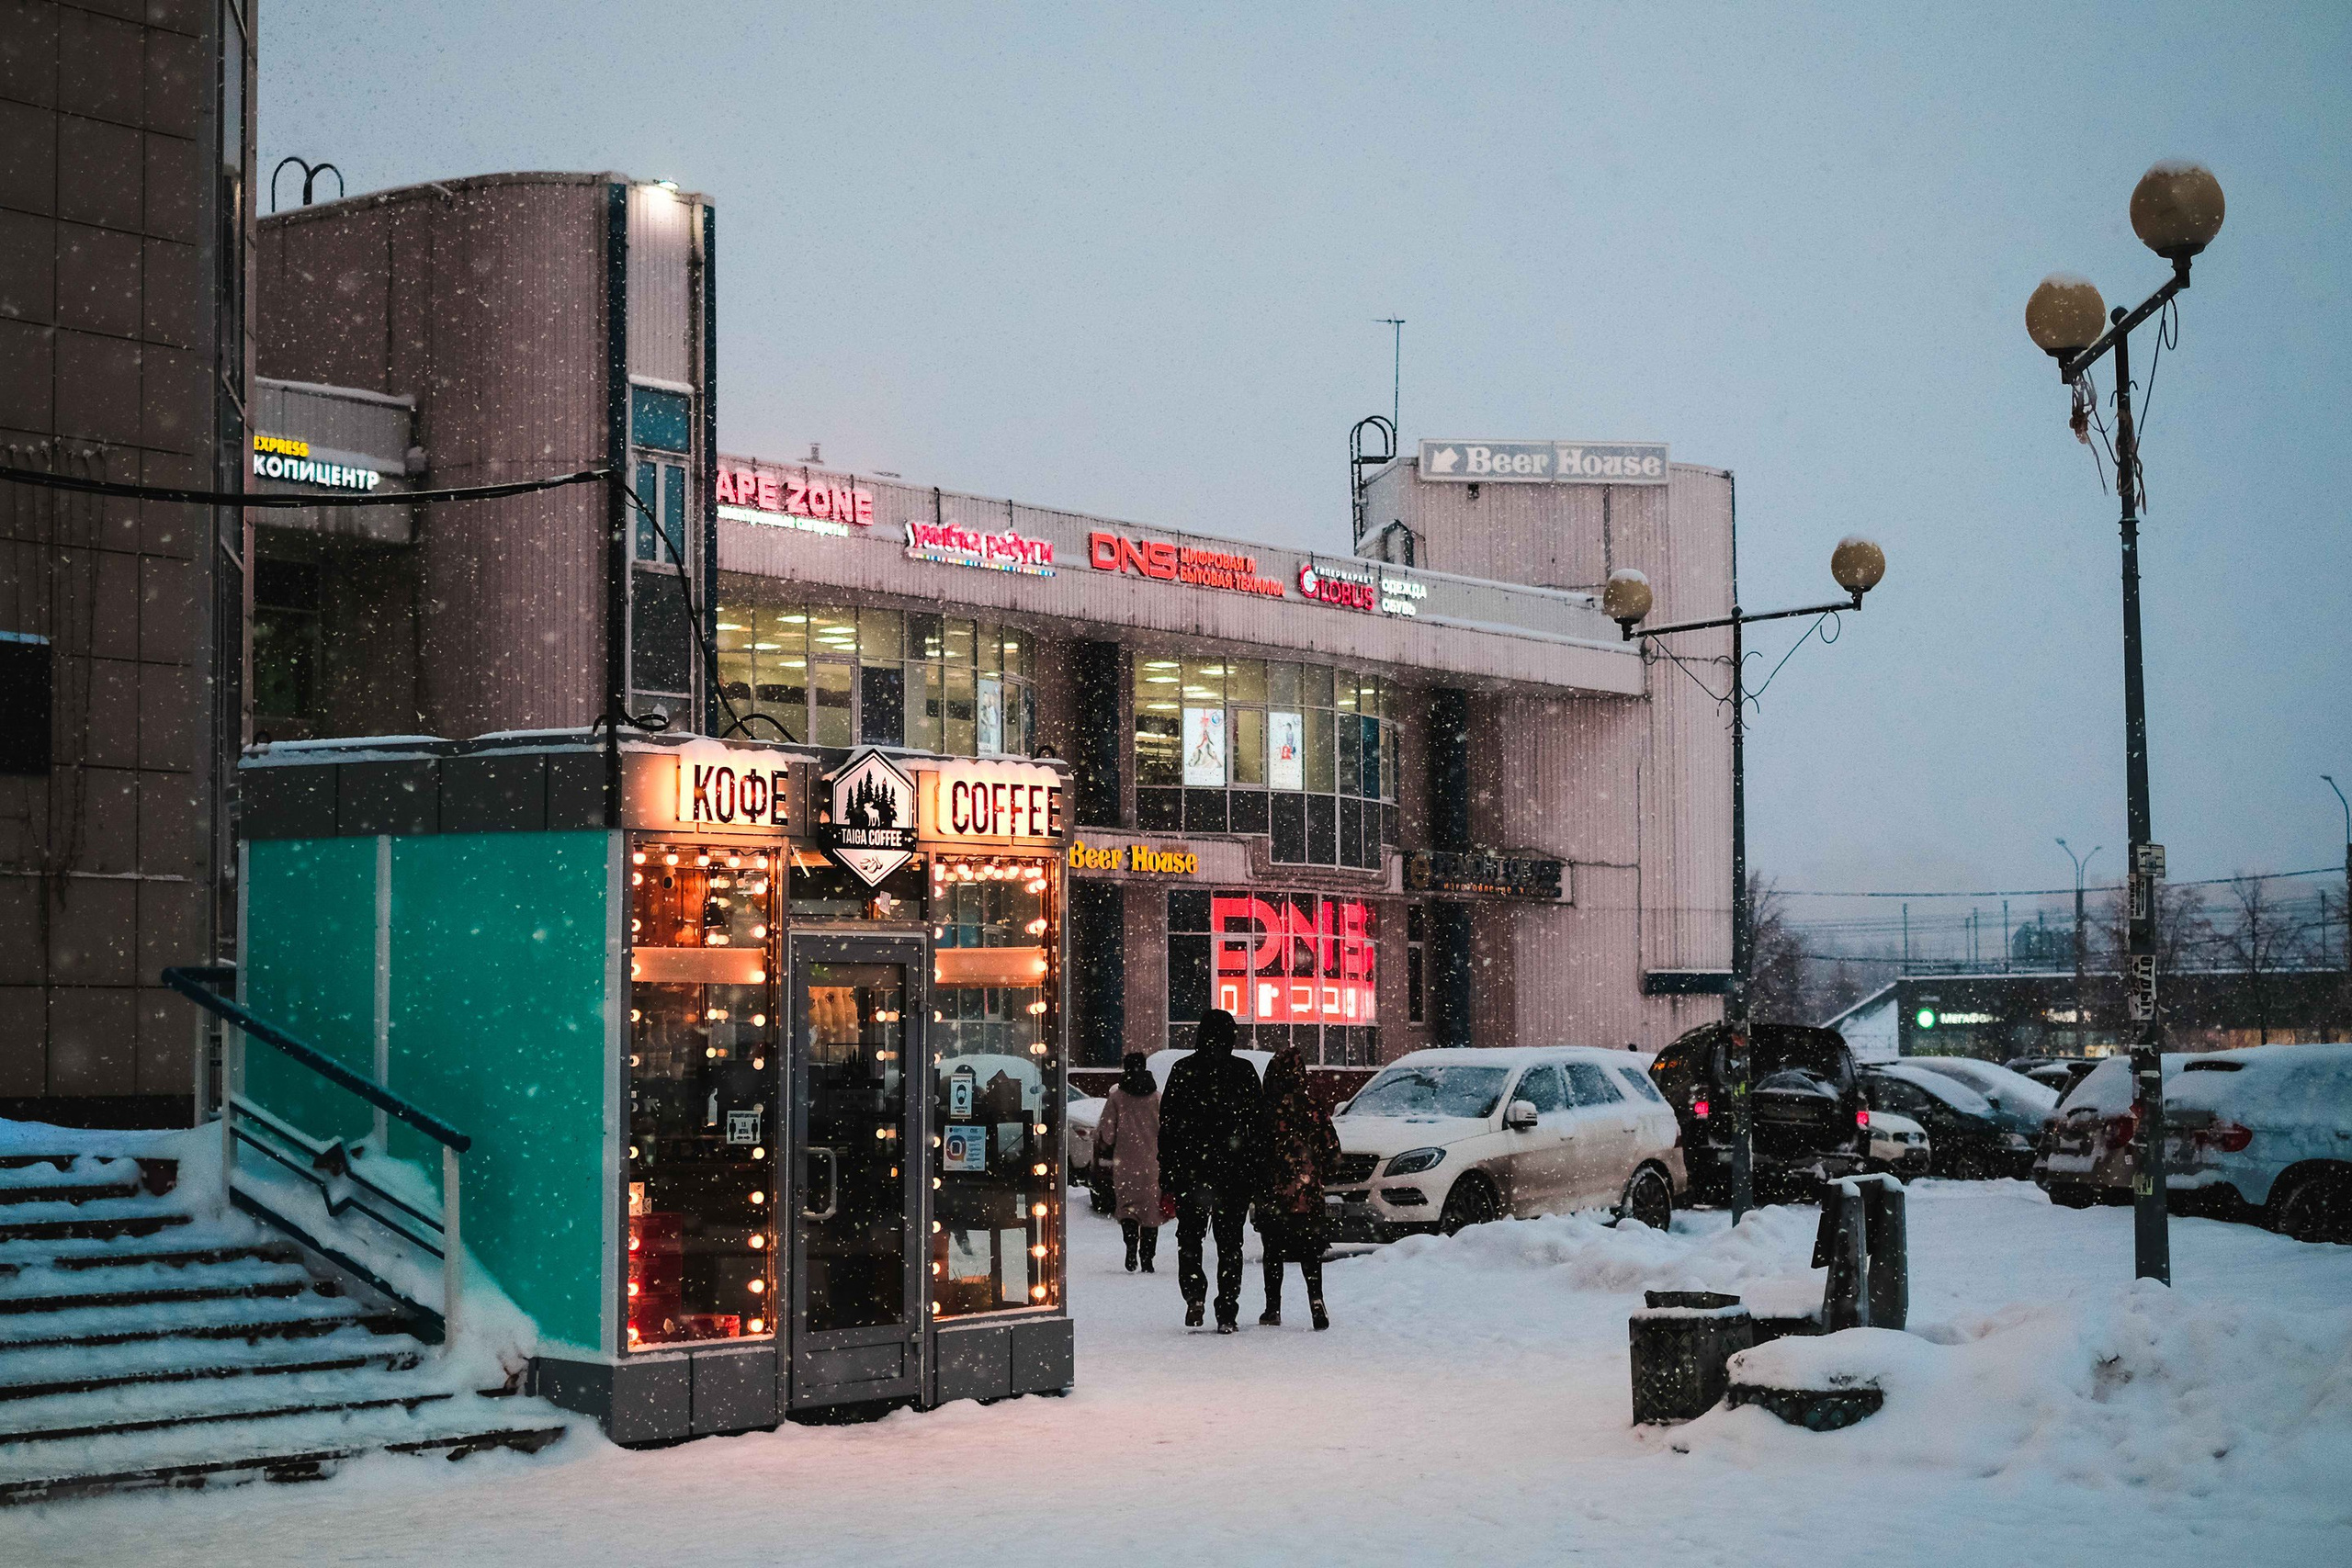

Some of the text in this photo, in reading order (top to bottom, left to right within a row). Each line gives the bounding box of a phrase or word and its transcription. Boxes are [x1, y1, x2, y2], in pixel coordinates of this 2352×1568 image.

[254, 435, 309, 457] EXPRESS
[1465, 446, 1662, 476] Beer House
[254, 454, 380, 490] КОПИЦЕНТР
[786, 479, 874, 525] ZONE
[1090, 531, 1177, 580] DNS
[1180, 547, 1245, 571] ЦИФРОВАЯ
[1180, 565, 1285, 597] БЫТОВАЯ ТЕХНИКА
[1381, 578, 1428, 601] ОДЕЖДА
[1381, 597, 1417, 616] ОБУВЬ
[693, 764, 790, 826] КОФЕ
[952, 780, 1063, 838] COFFEE
[841, 829, 903, 848] TAIGA COFFEE
[1069, 840, 1200, 874] Beer House
